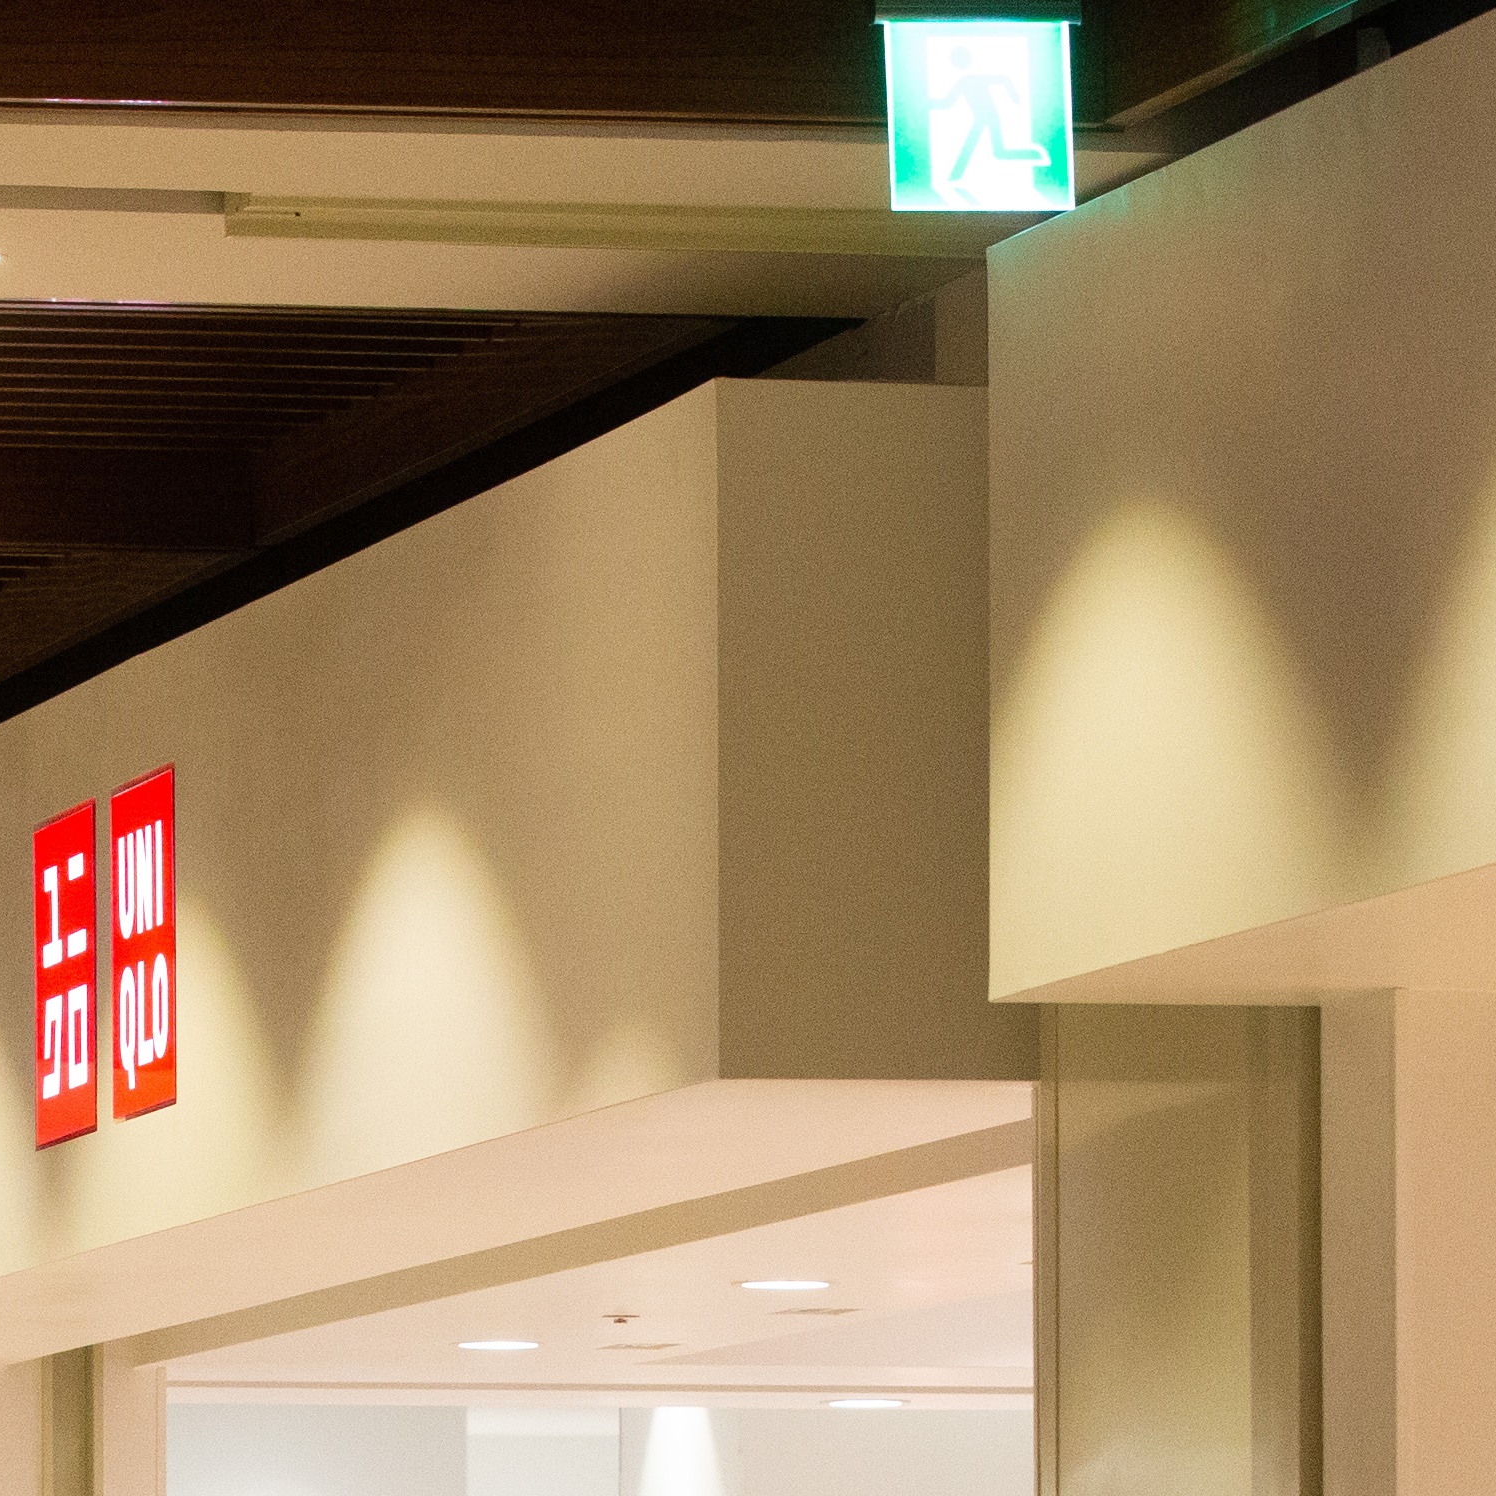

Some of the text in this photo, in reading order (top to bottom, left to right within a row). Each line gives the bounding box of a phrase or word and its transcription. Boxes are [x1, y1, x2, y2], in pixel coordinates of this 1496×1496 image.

[42, 852, 87, 969] ユニ
[116, 819, 164, 940] UNI
[42, 983, 88, 1100] クロ
[118, 952, 169, 1091] QLO
